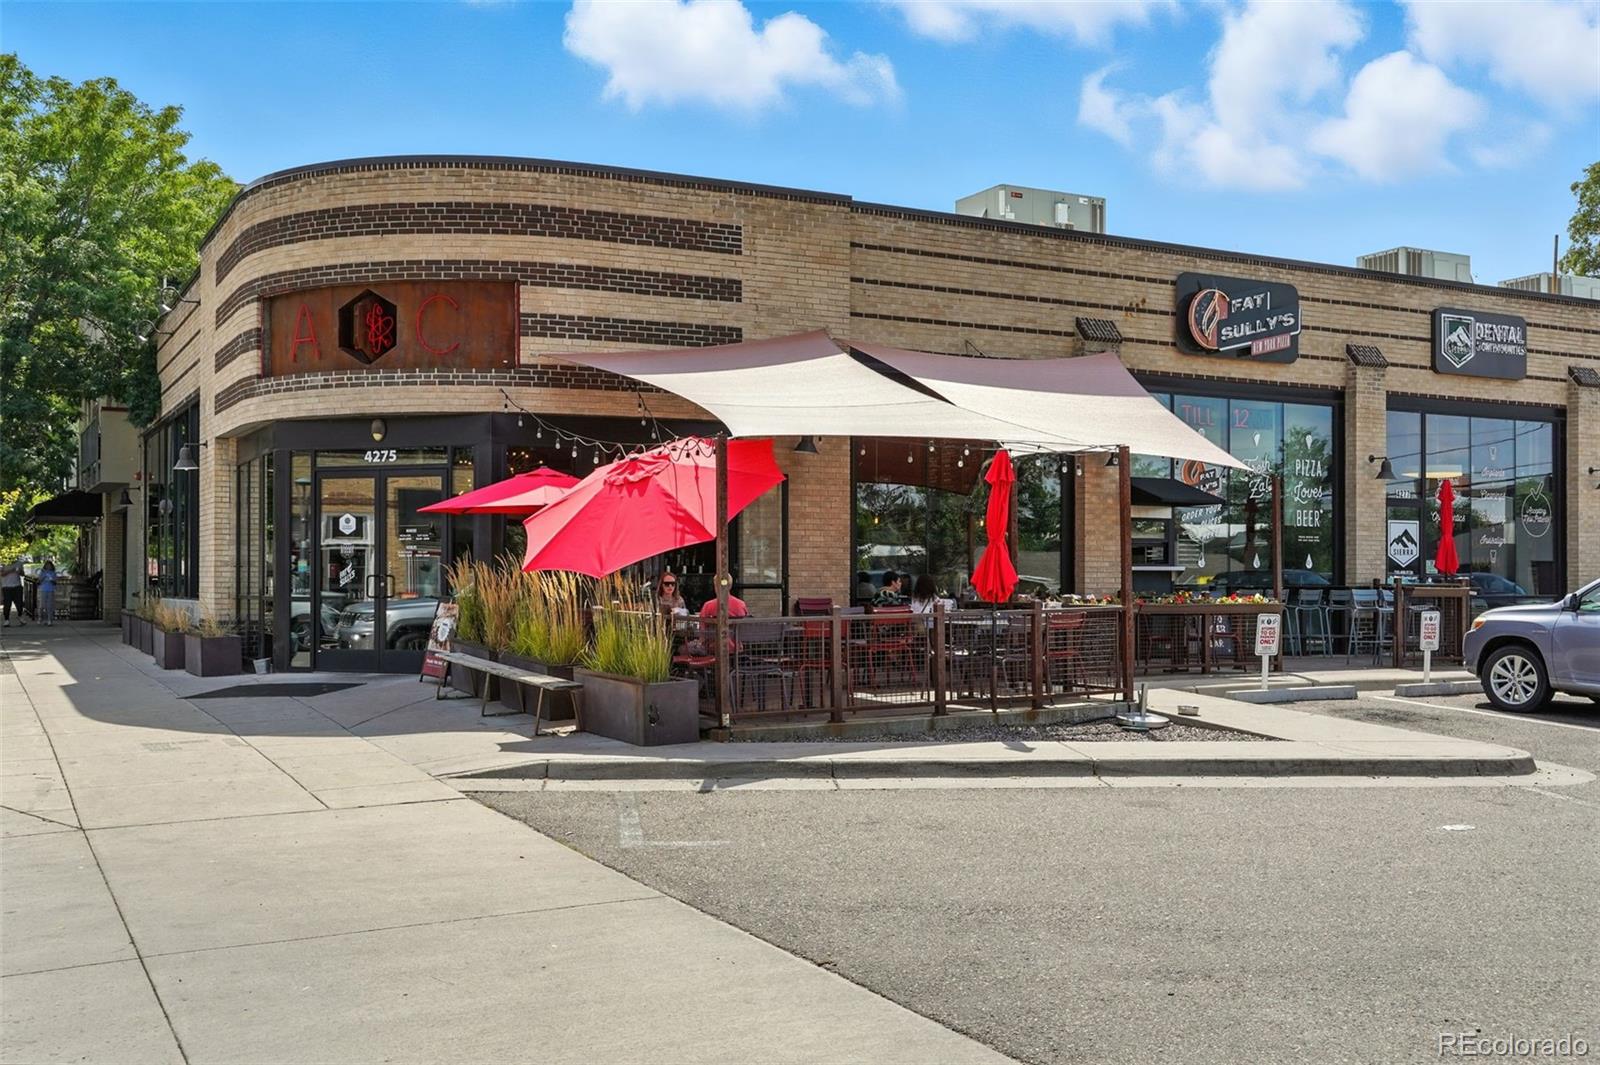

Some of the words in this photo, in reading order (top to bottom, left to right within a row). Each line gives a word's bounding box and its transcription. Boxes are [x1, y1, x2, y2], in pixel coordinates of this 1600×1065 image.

[1231, 293, 1266, 313] FAT
[290, 303, 322, 363] A
[415, 294, 460, 355] C
[1221, 312, 1296, 340] SULLY'S
[1475, 321, 1525, 344] DENTAL
[1182, 404, 1215, 427] TILL
[1233, 408, 1249, 429] 12
[364, 449, 397, 463] 4275
[1200, 471, 1215, 481] FAT
[1295, 459, 1322, 477] PIZZA
[1294, 481, 1323, 504] Loves
[1181, 508, 1204, 521] ORDER
[1296, 510, 1320, 527] BEER
[1393, 548, 1414, 556] SIERRA
